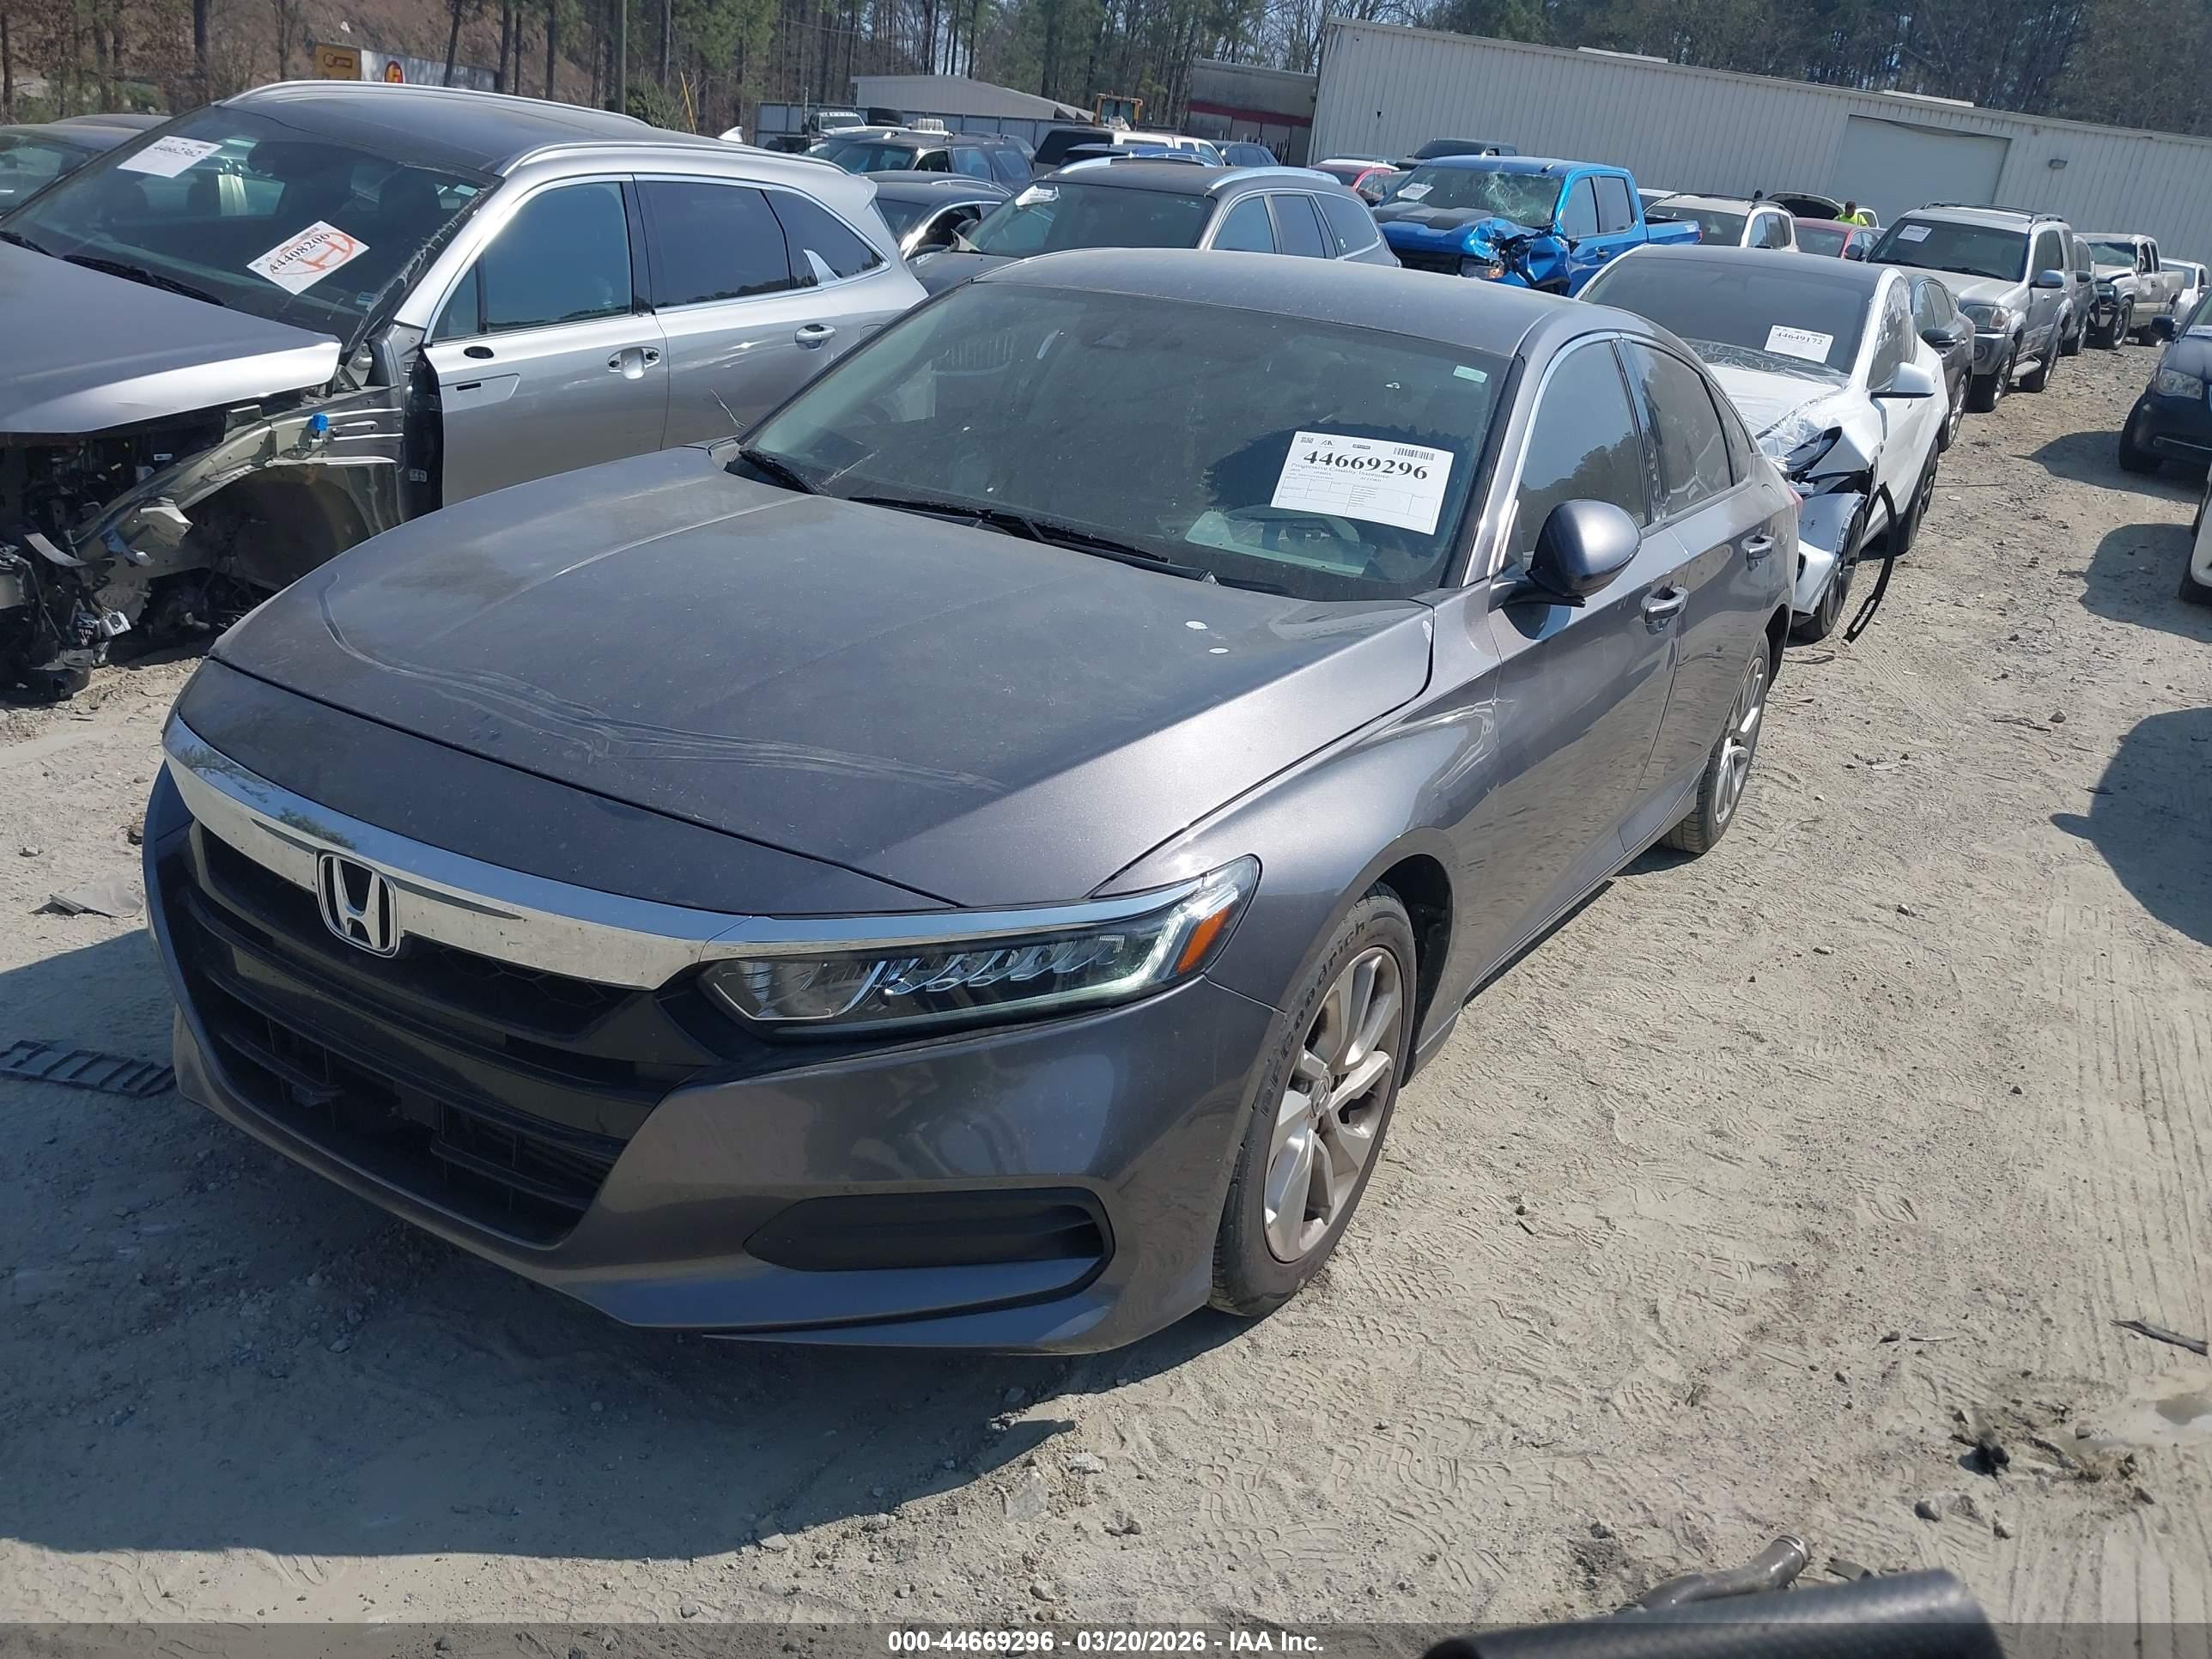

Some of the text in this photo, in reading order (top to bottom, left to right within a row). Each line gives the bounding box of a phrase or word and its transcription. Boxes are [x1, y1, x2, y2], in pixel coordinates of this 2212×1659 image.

[269, 233, 331, 274] 44408206
[1776, 331, 1823, 345] 44649172
[1304, 450, 1429, 480] 44669296
[1261, 920, 1366, 1117] BFGoodrich
